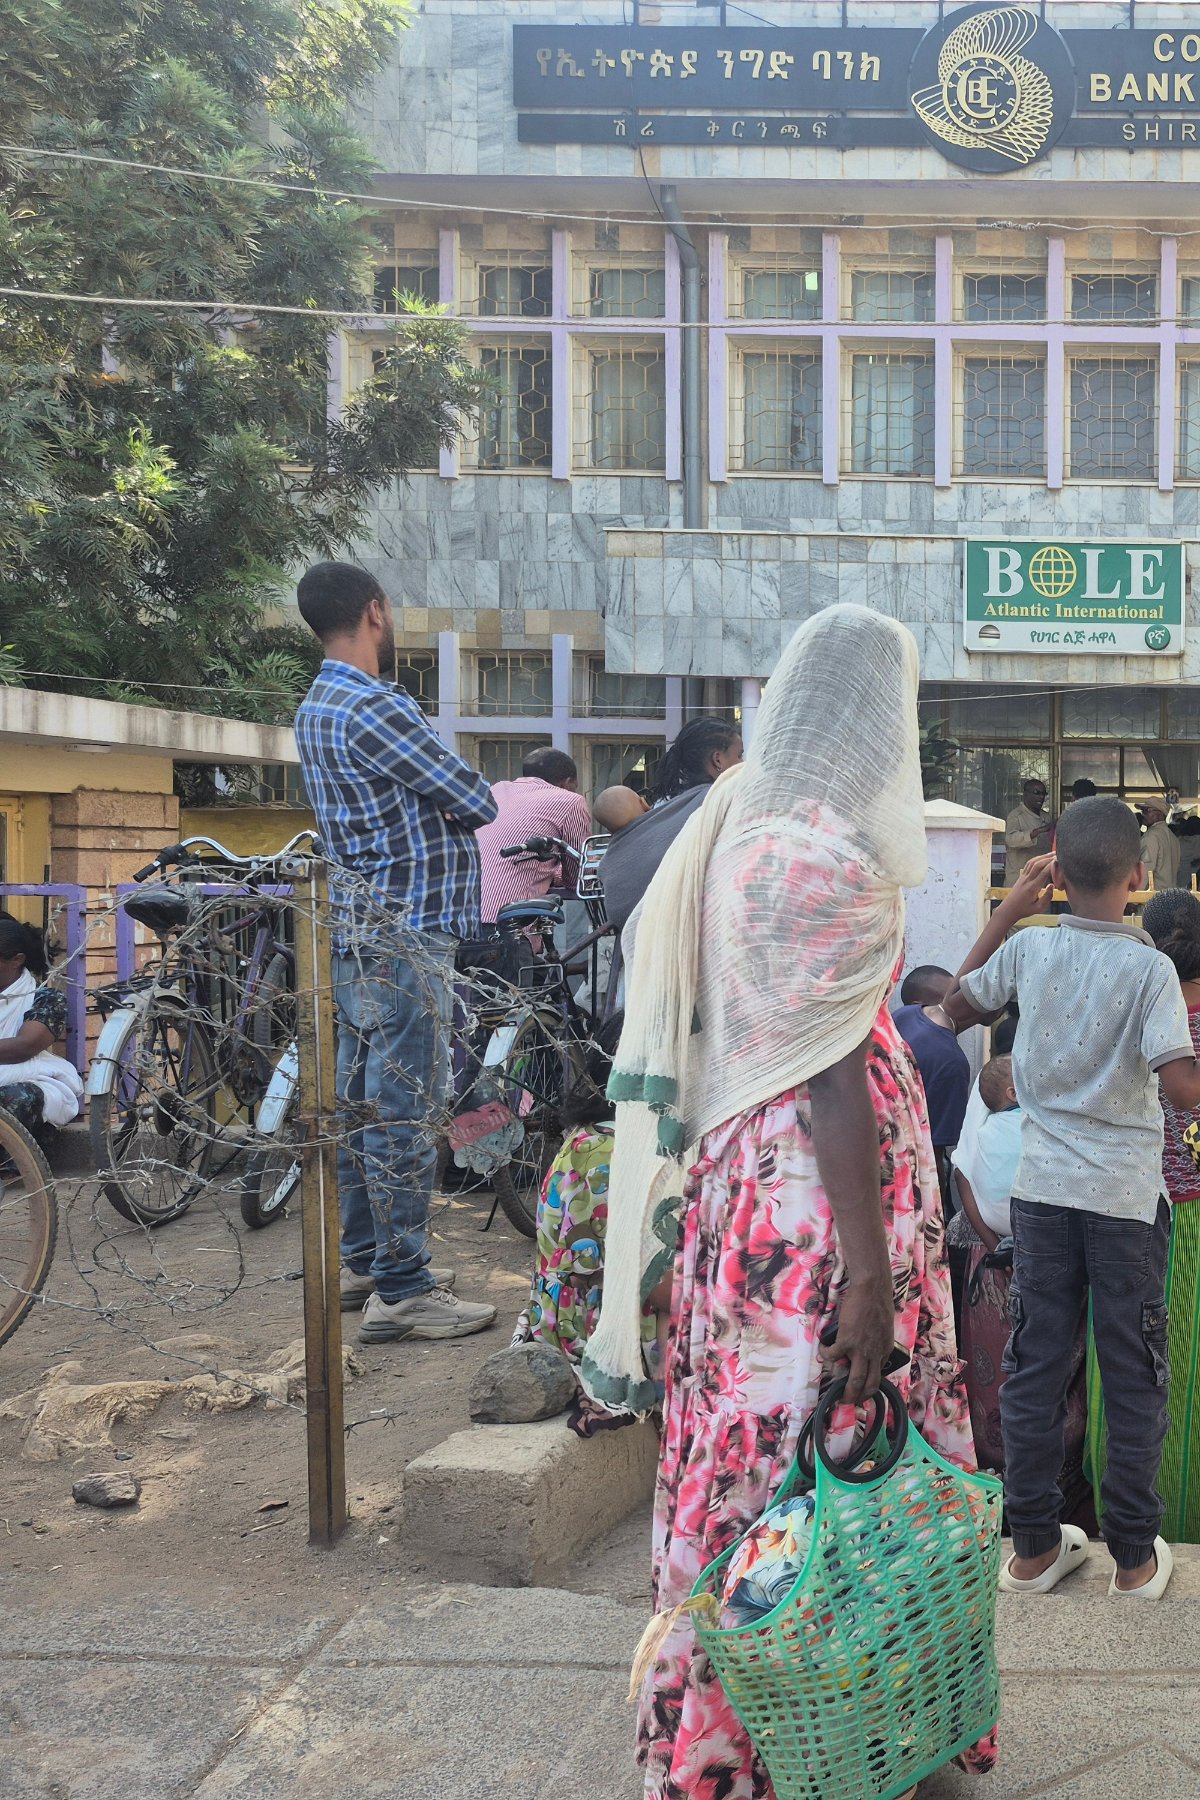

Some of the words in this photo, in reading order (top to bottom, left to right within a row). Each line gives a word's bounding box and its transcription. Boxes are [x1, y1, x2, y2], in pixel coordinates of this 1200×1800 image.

[536, 48, 698, 79] የኢትዮጵያ
[716, 49, 795, 80] ንግድ
[812, 50, 881, 81] ባንክ
[1090, 73, 1196, 101] BANK
[613, 119, 655, 136] ሽሬ
[706, 120, 827, 139] ቅርንጫፍ
[984, 603, 1050, 617] Atlantic
[1055, 603, 1164, 619] International
